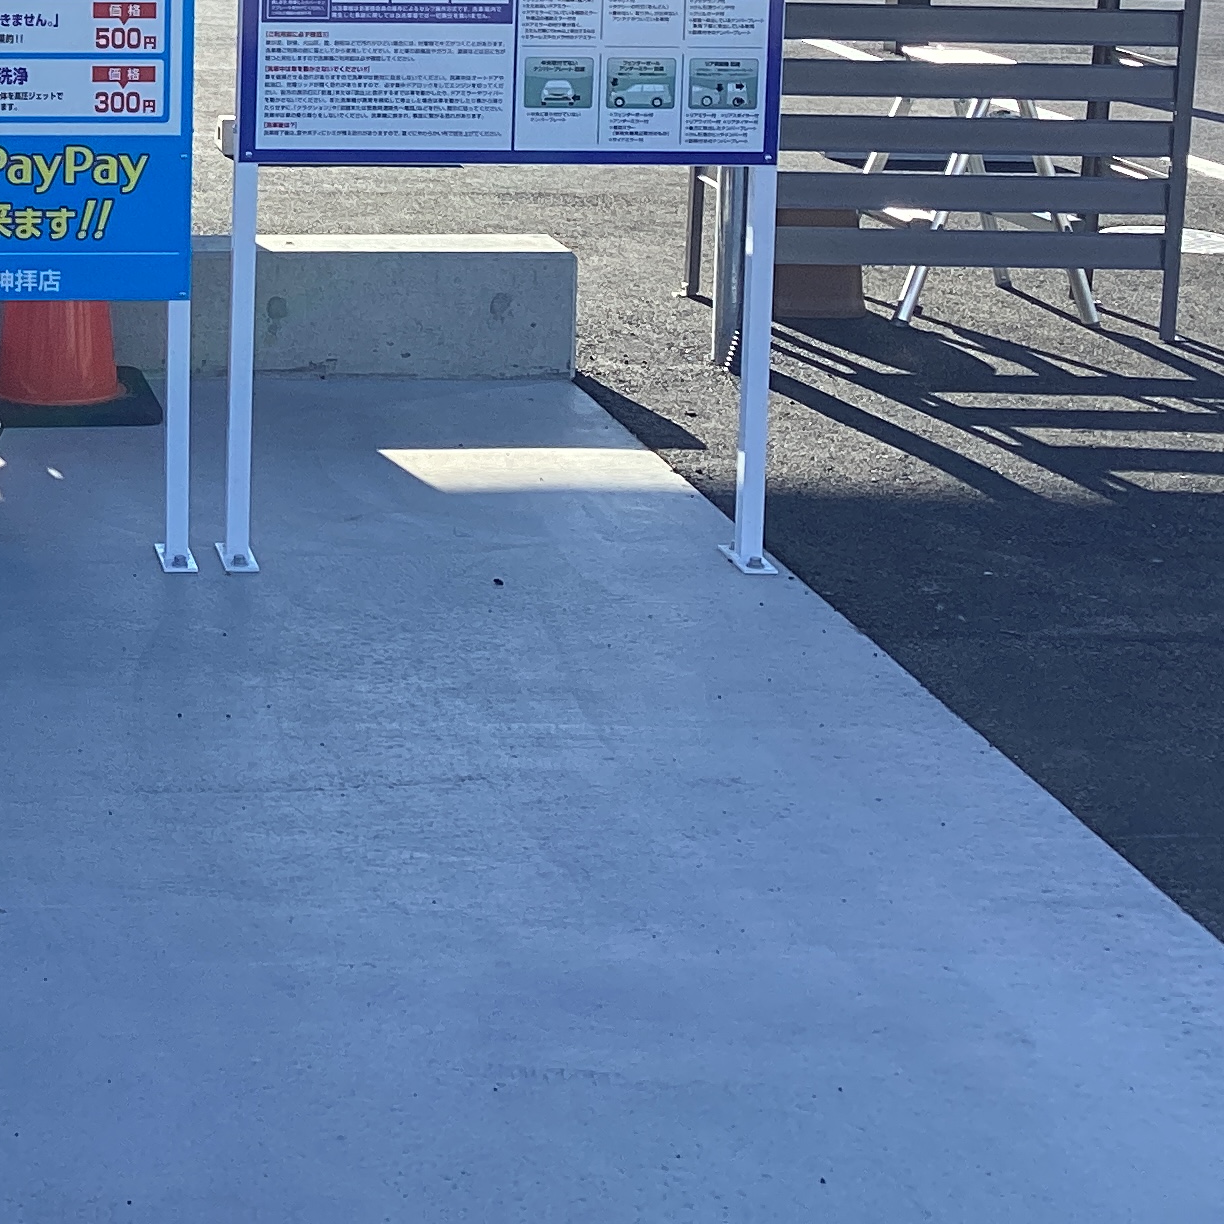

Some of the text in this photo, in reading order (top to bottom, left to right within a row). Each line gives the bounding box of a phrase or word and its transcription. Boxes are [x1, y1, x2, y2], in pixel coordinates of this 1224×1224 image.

[109, 4, 141, 17] 価格
[95, 27, 157, 50] 500円
[109, 69, 140, 82] 価格
[94, 91, 156, 114] 300円
